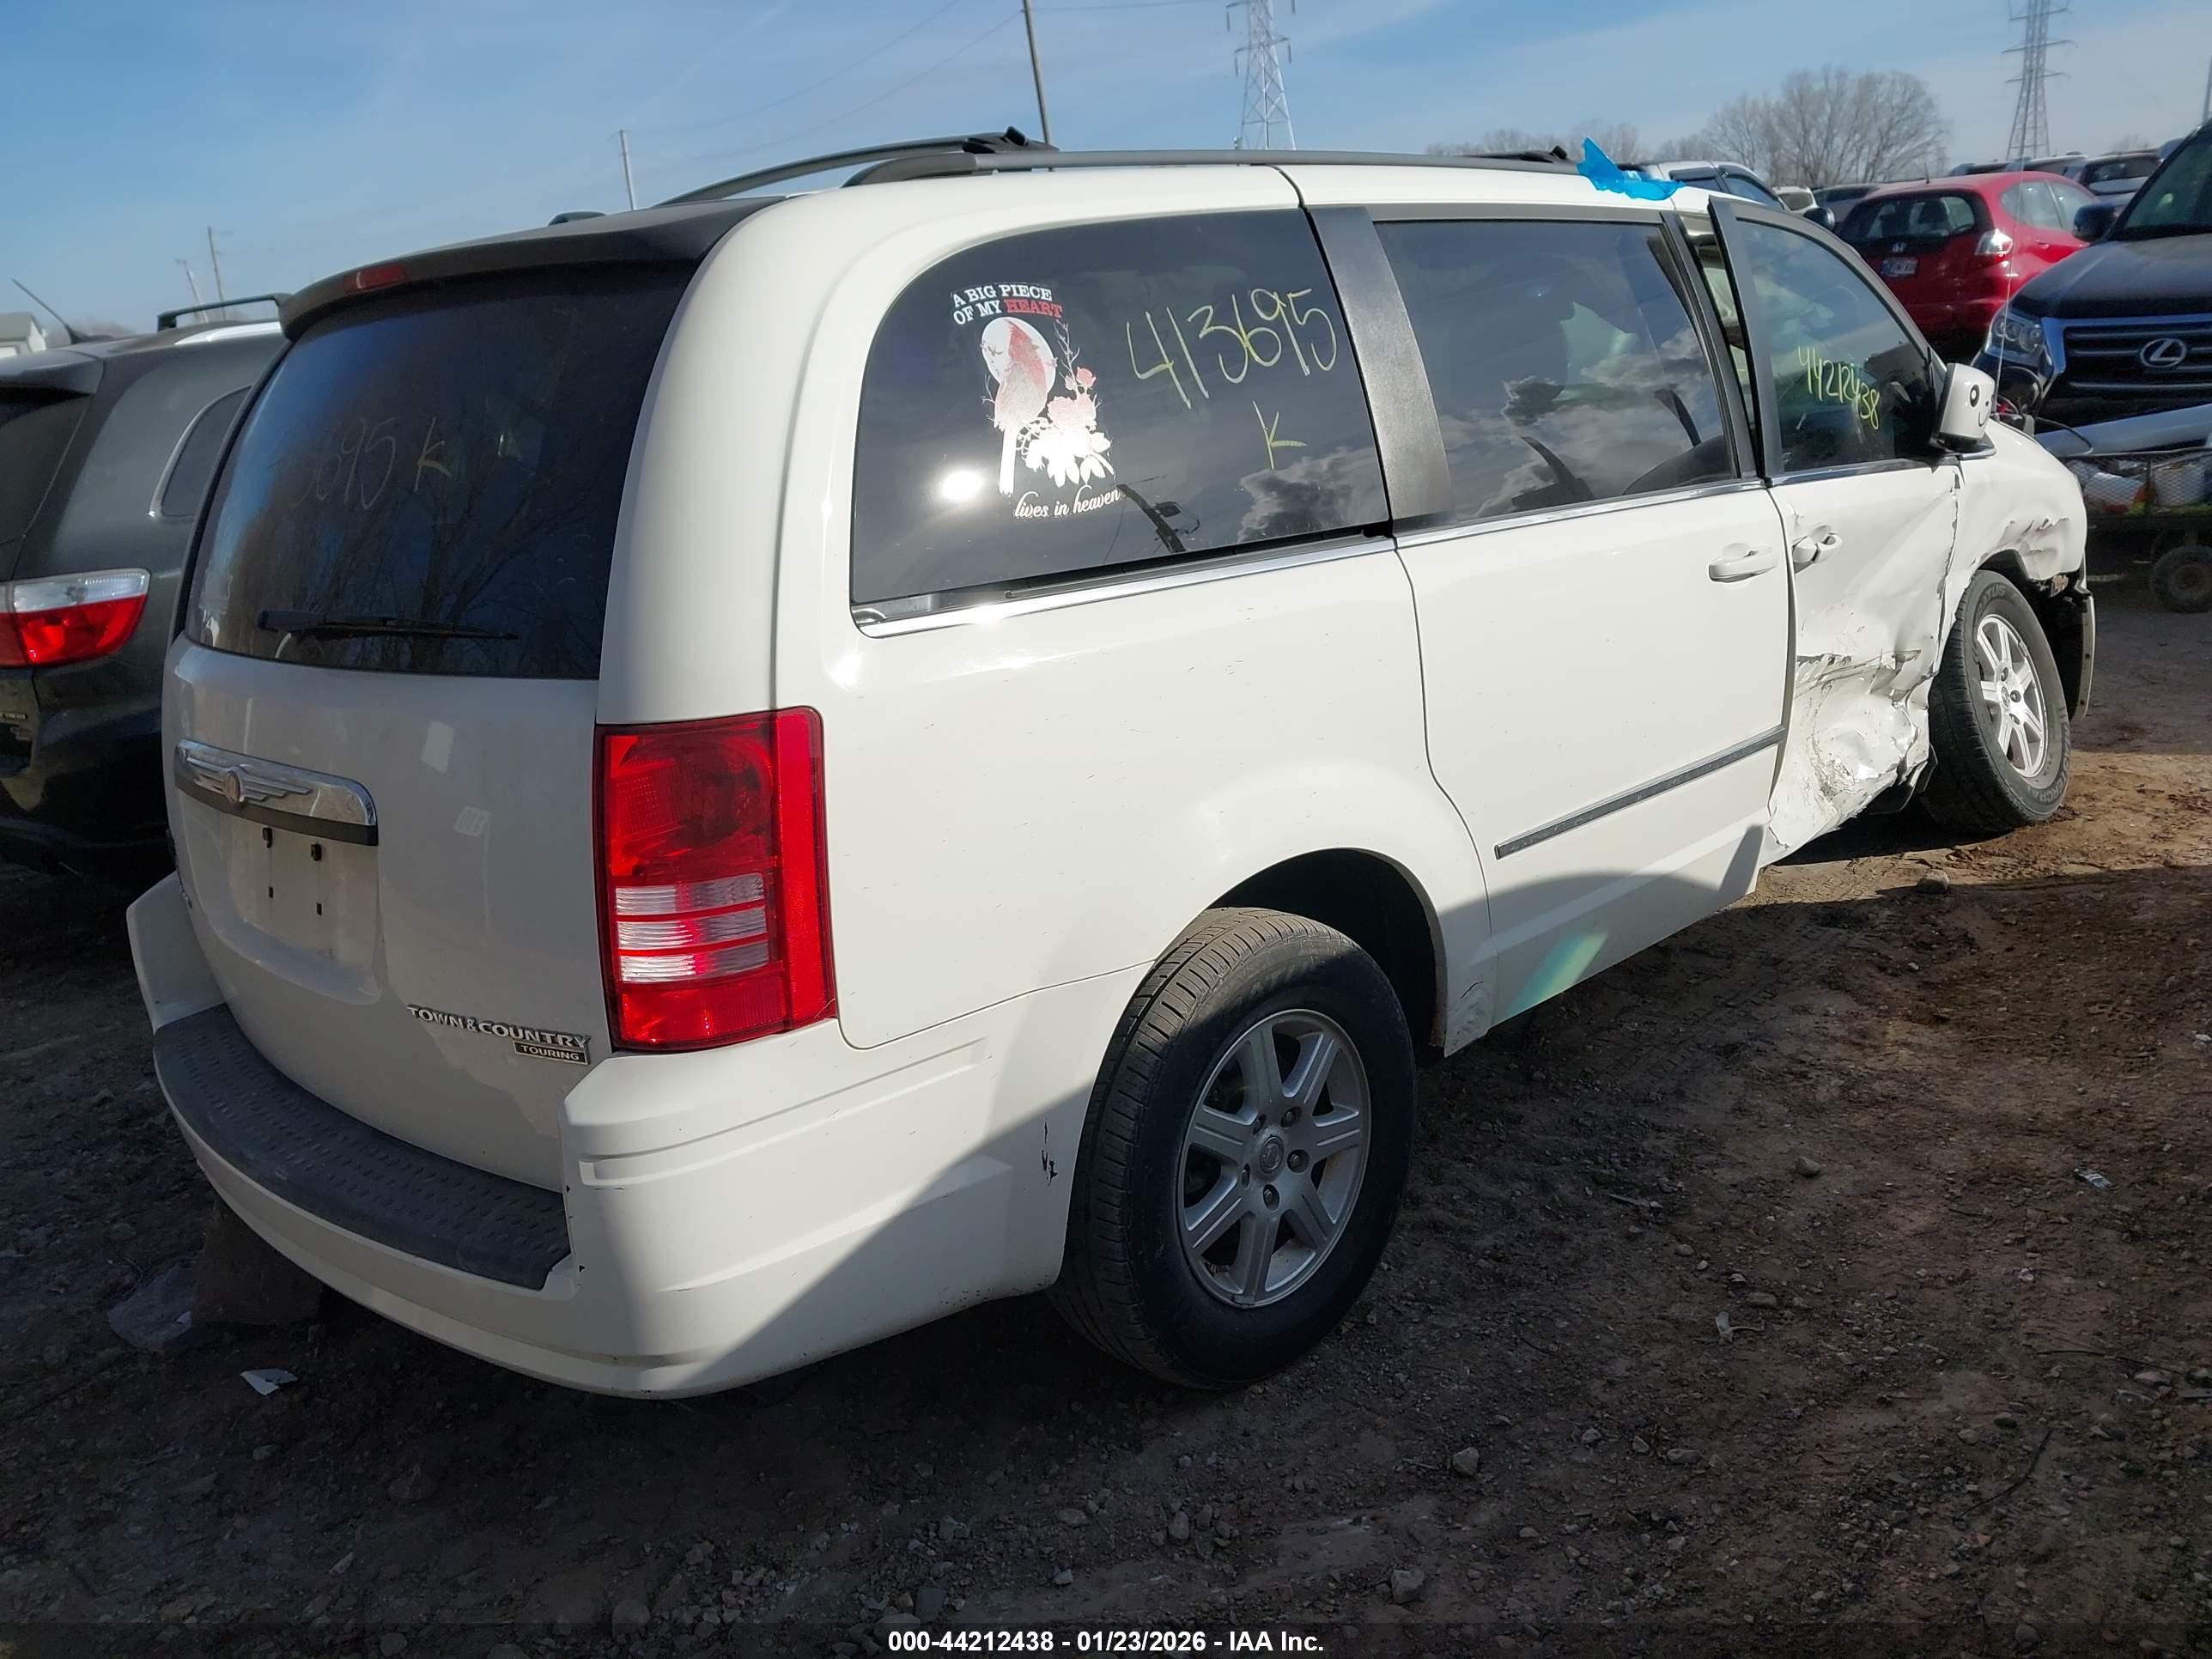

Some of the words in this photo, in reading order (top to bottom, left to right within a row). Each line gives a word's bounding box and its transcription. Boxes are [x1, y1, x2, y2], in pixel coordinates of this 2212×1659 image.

[952, 294, 966, 308] A
[964, 285, 997, 302] BIG
[998, 284, 1053, 301] PIECE
[953, 306, 975, 325] OF
[975, 300, 1003, 318] MY
[1003, 298, 1063, 319] HEART
[1126, 289, 1337, 410] 413695
[1252, 399, 1308, 471] K
[1014, 490, 1049, 517] lives
[1054, 501, 1070, 517] in
[1073, 484, 1121, 514] heaven
[520, 1044, 580, 1061] TOURING
